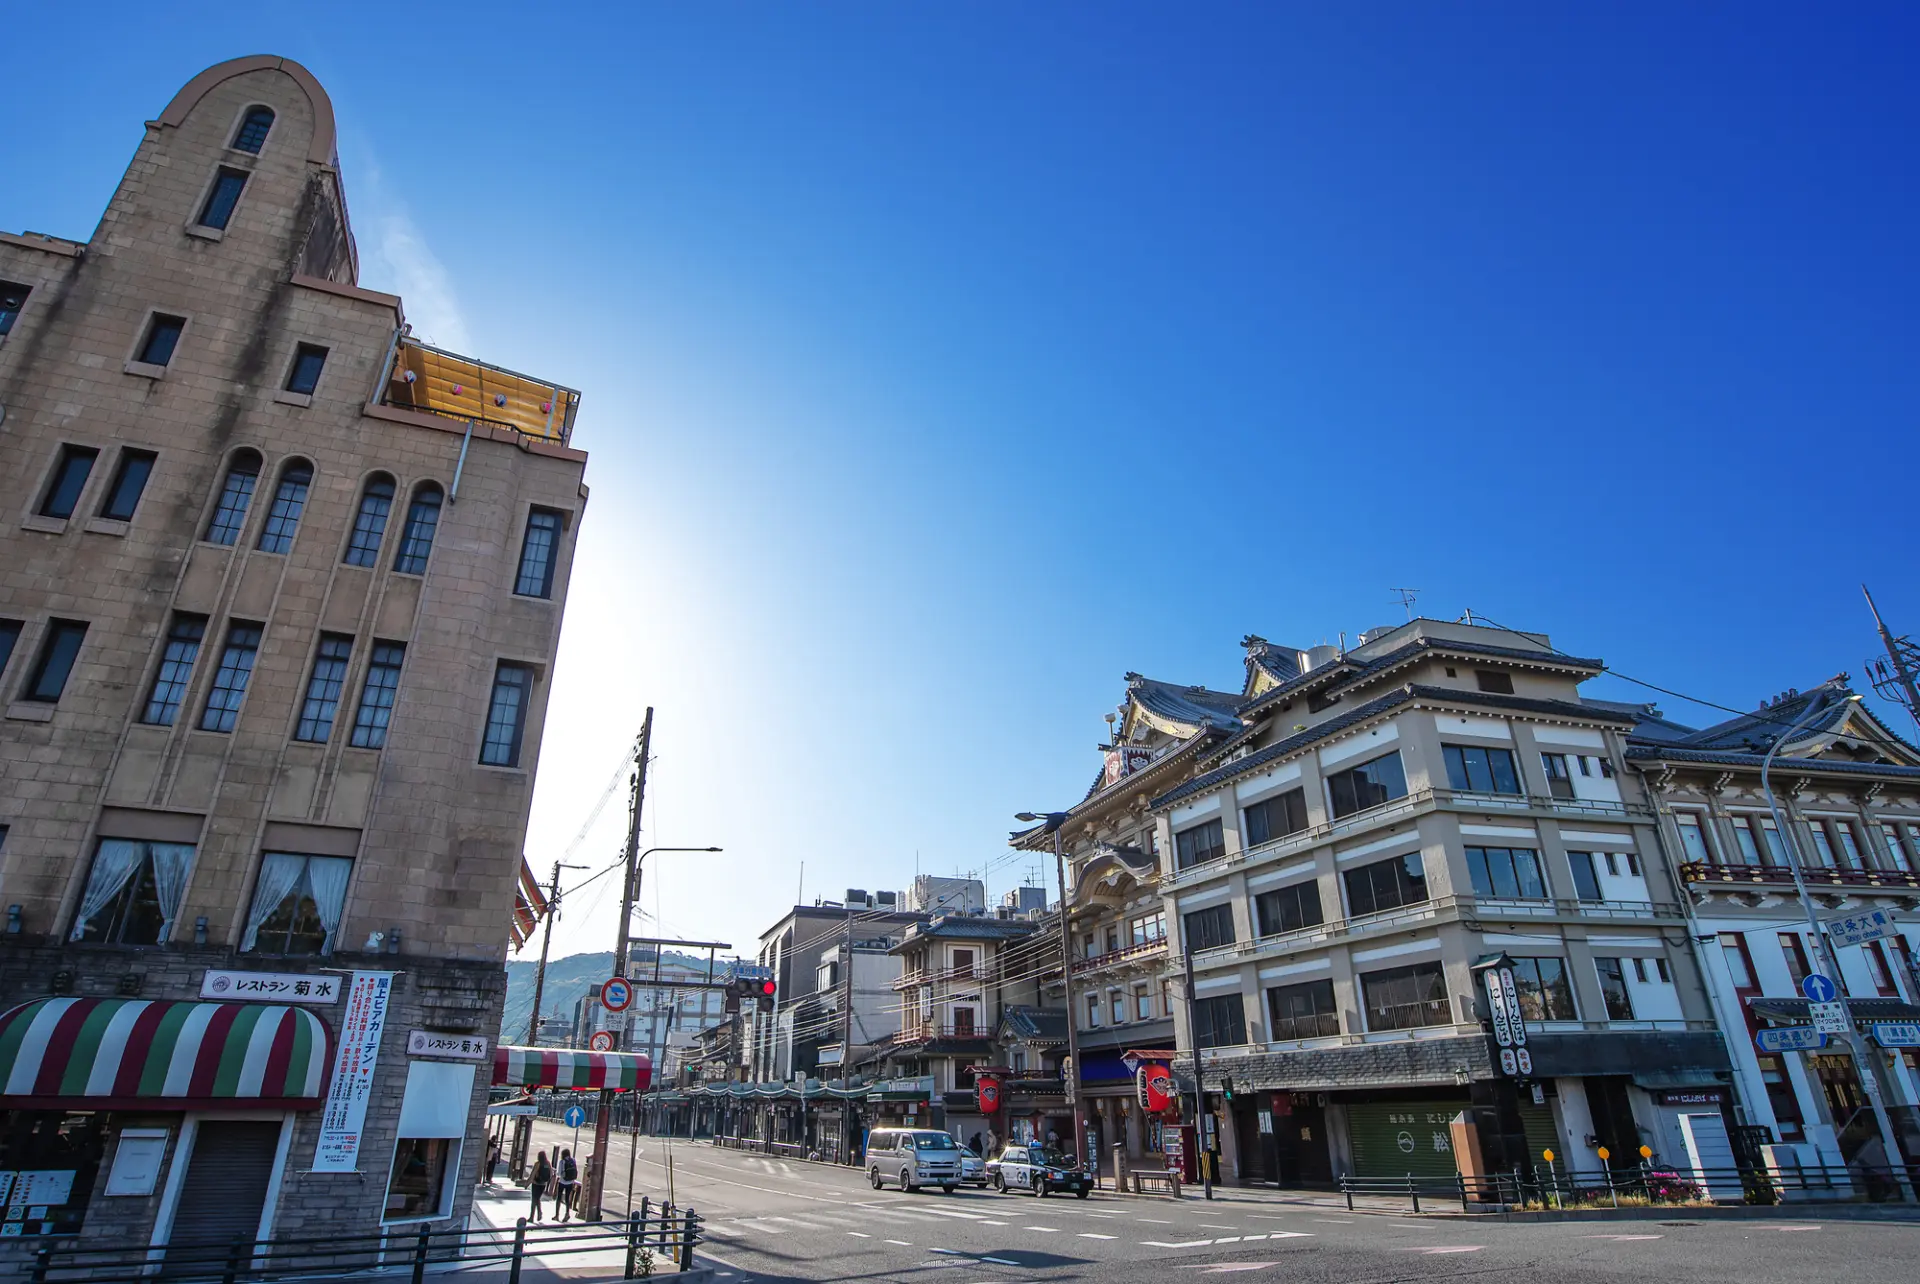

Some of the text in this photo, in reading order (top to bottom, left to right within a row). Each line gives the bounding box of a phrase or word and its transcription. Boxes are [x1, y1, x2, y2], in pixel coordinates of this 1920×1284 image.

[1831, 911, 1886, 936] 四条大橋
[236, 979, 332, 996] レストラン 菊水
[362, 977, 389, 1064] 屋上ビアガーデン
[1489, 988, 1510, 1043] にしんそば
[1504, 986, 1524, 1042] にしんそば
[428, 1039, 483, 1054] レストラン 菊水
[1767, 1029, 1813, 1043] 四条通り
